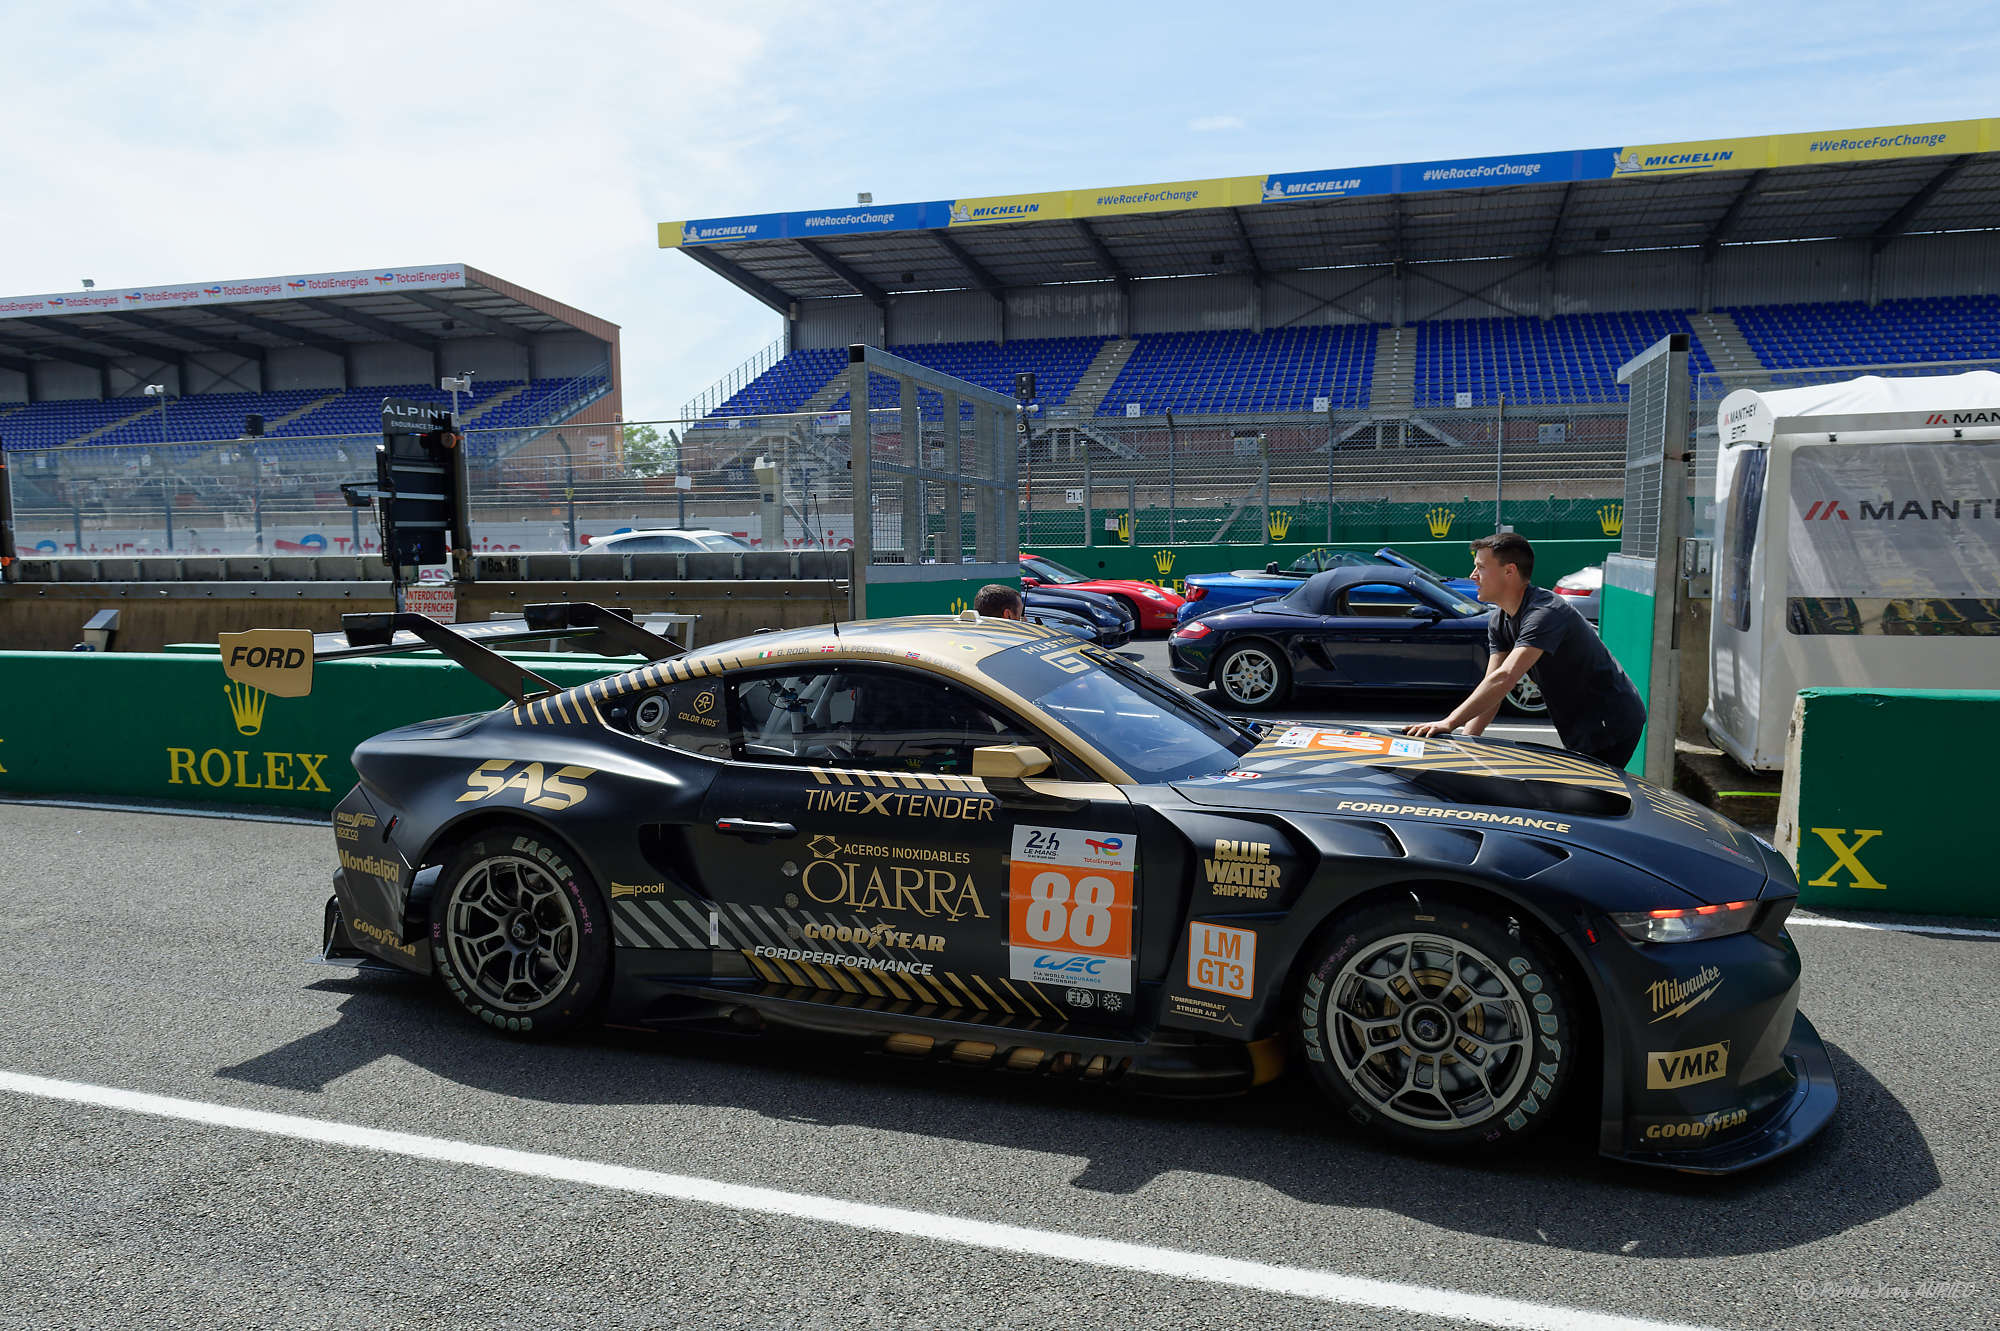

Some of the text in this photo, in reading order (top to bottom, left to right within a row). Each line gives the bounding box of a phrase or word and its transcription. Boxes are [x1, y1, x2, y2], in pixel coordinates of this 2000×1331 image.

[1809, 132, 1946, 152] #WeRaceForChange
[1645, 151, 1733, 166] MICHELIN
[1423, 163, 1541, 181] #WeRaceForChange
[1287, 179, 1360, 193] MICHELIN
[1096, 189, 1199, 206] #WeRaceForChange
[973, 204, 1039, 217] MICHELIN
[805, 213, 894, 227] #WeRaceForChange
[700, 225, 757, 237] MICHELIN
[307, 277, 369, 289] TotalEnergies
[395, 271, 460, 283] TotalEnergies
[143, 290, 199, 301] TotalEnergies
[223, 283, 282, 296] TotalEnergies
[64, 296, 119, 307] TotalEnergies
[1730, 403, 1757, 422] MANTHEY
[391, 420, 428, 430] ENDURANCE
[1860, 499, 2000, 520] MANT
[414, 603, 422, 612] SE
[423, 602, 454, 612] PENCHER
[230, 646, 305, 669] FORD
[678, 712, 700, 724] COLOR
[167, 748, 331, 792] ROLEX
[456, 760, 599, 811] SAS
[805, 789, 995, 822] TIMEXTENDER
[337, 827, 359, 839] sparco
[512, 836, 573, 880] EAGLE
[843, 843, 970, 864] ACEROS INOXIDABLES
[1215, 838, 1271, 865] BLUE
[339, 849, 399, 884] Mondialpol
[1084, 857, 1122, 867] TotalEnergies
[1204, 858, 1281, 888] WATER
[634, 882, 665, 897] paoli
[802, 860, 991, 922] OLARRA
[1212, 883, 1268, 899] SHIPPING
[1025, 871, 1116, 948] 88
[1203, 928, 1241, 961] LM
[1033, 954, 1106, 975] WEC
[1033, 976, 1078, 985] CHAMPIONSHIP
[1066, 975, 1101, 984] ENDURANCE
[1196, 957, 1244, 991] GT3
[1645, 965, 1721, 1013] Milwaukee
[1303, 972, 1325, 1062] EAGLE
[1658, 1050, 1719, 1083] VMR
